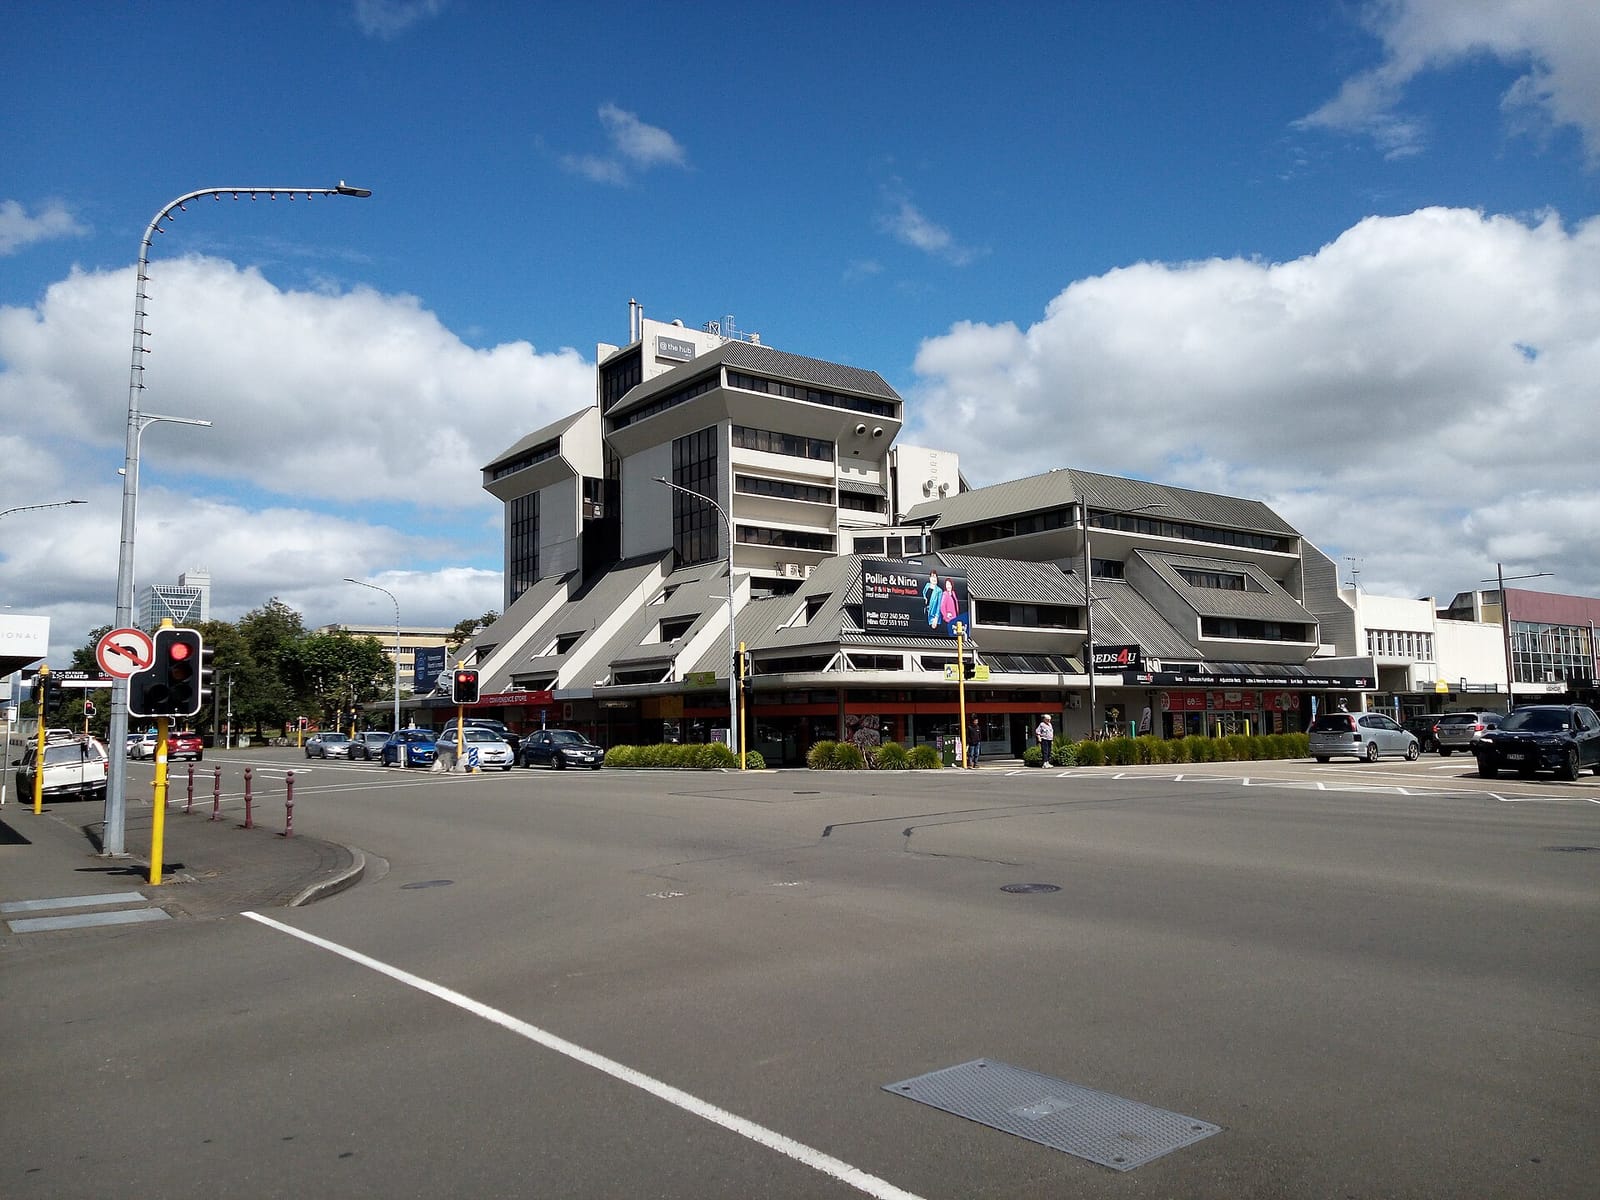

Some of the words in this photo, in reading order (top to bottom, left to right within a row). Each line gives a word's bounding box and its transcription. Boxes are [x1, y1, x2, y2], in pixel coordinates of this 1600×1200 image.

[668, 343, 678, 351] the
[679, 345, 691, 353] hub
[865, 573, 888, 584] Pollie
[889, 574, 896, 585] &
[897, 576, 917, 586] Nina
